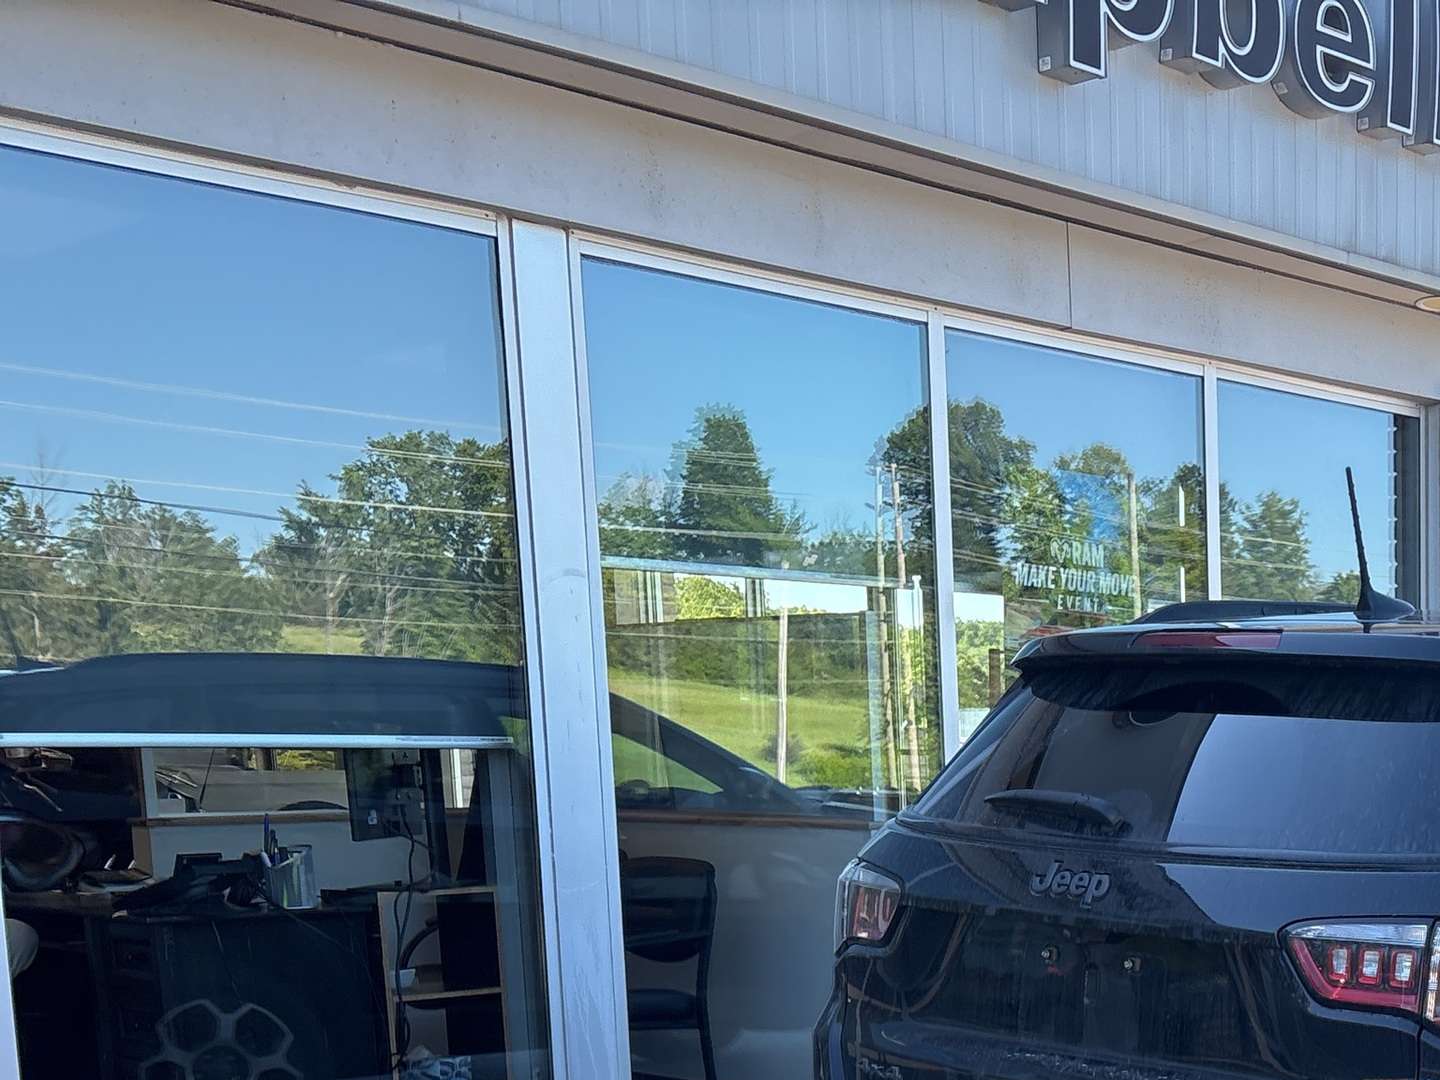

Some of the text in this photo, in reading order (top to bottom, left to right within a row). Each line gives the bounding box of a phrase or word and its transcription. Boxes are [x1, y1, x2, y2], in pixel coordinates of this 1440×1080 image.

[1072, 541, 1105, 568] RAM
[1015, 560, 1138, 598] MAKE YOUR MOVE
[1057, 594, 1100, 612] EVENT
[1029, 860, 1110, 909] Jeep
